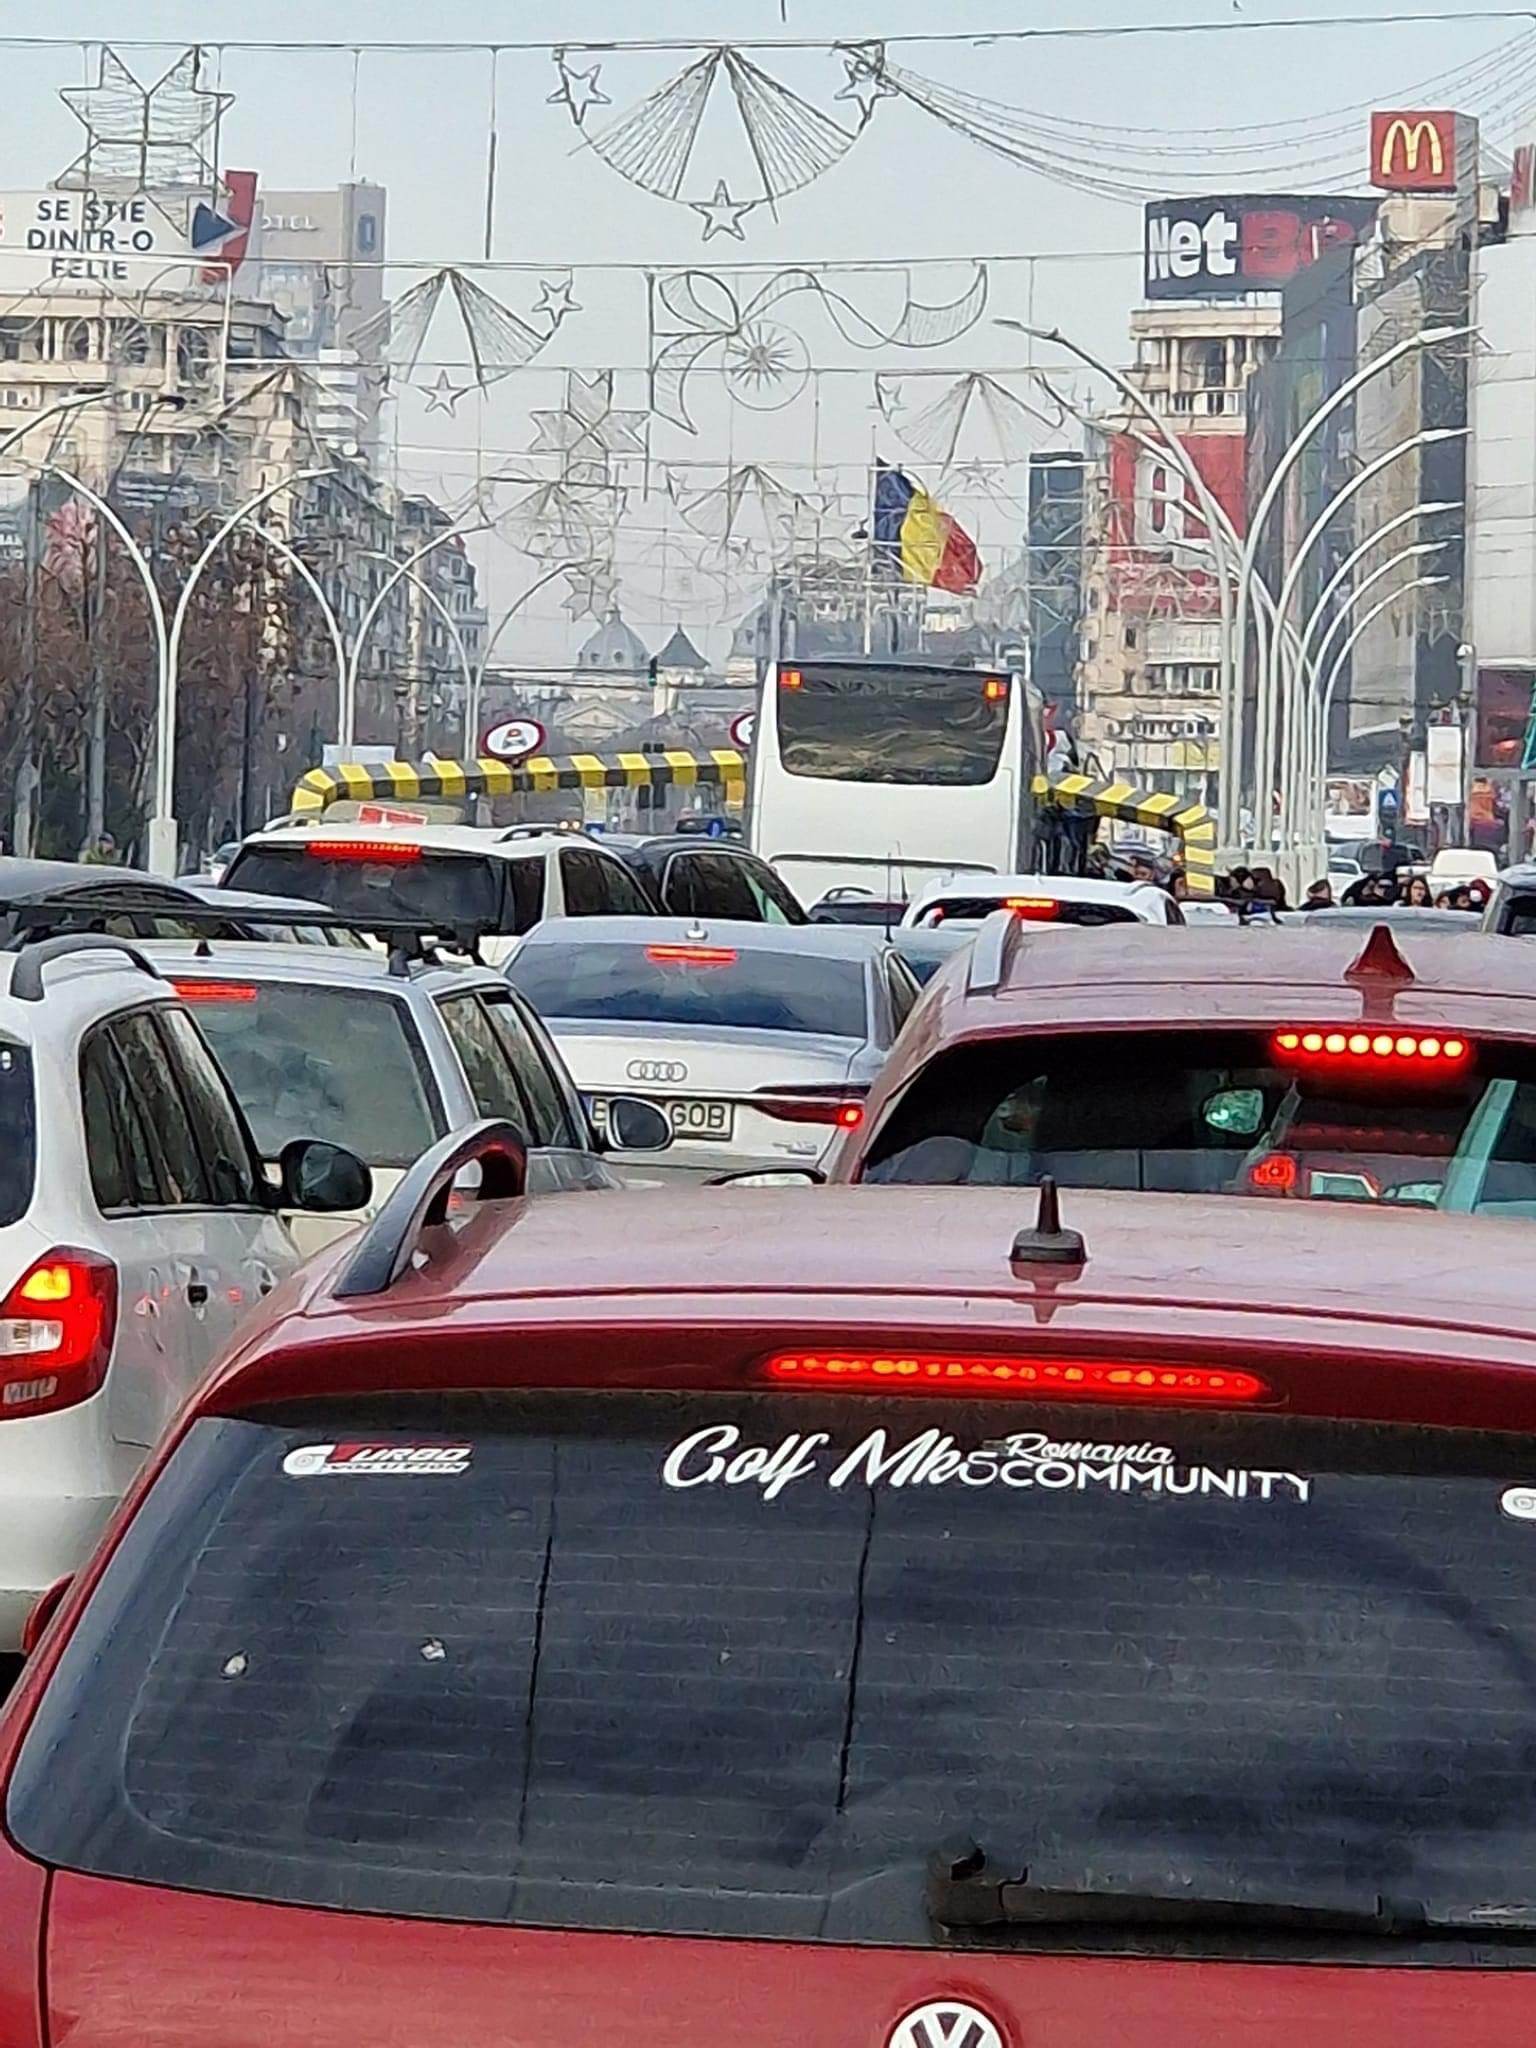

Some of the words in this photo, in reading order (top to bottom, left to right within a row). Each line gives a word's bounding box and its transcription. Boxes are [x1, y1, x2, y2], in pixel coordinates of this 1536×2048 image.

[37, 199, 70, 221] SE
[27, 228, 154, 251] DINTR-O
[51, 256, 129, 280] FELIE
[670, 1103, 726, 1128] GOB
[1005, 1432, 1176, 1466] Romania
[663, 1424, 830, 1500] Golf
[999, 1460, 1309, 1502] COMMUNITY
